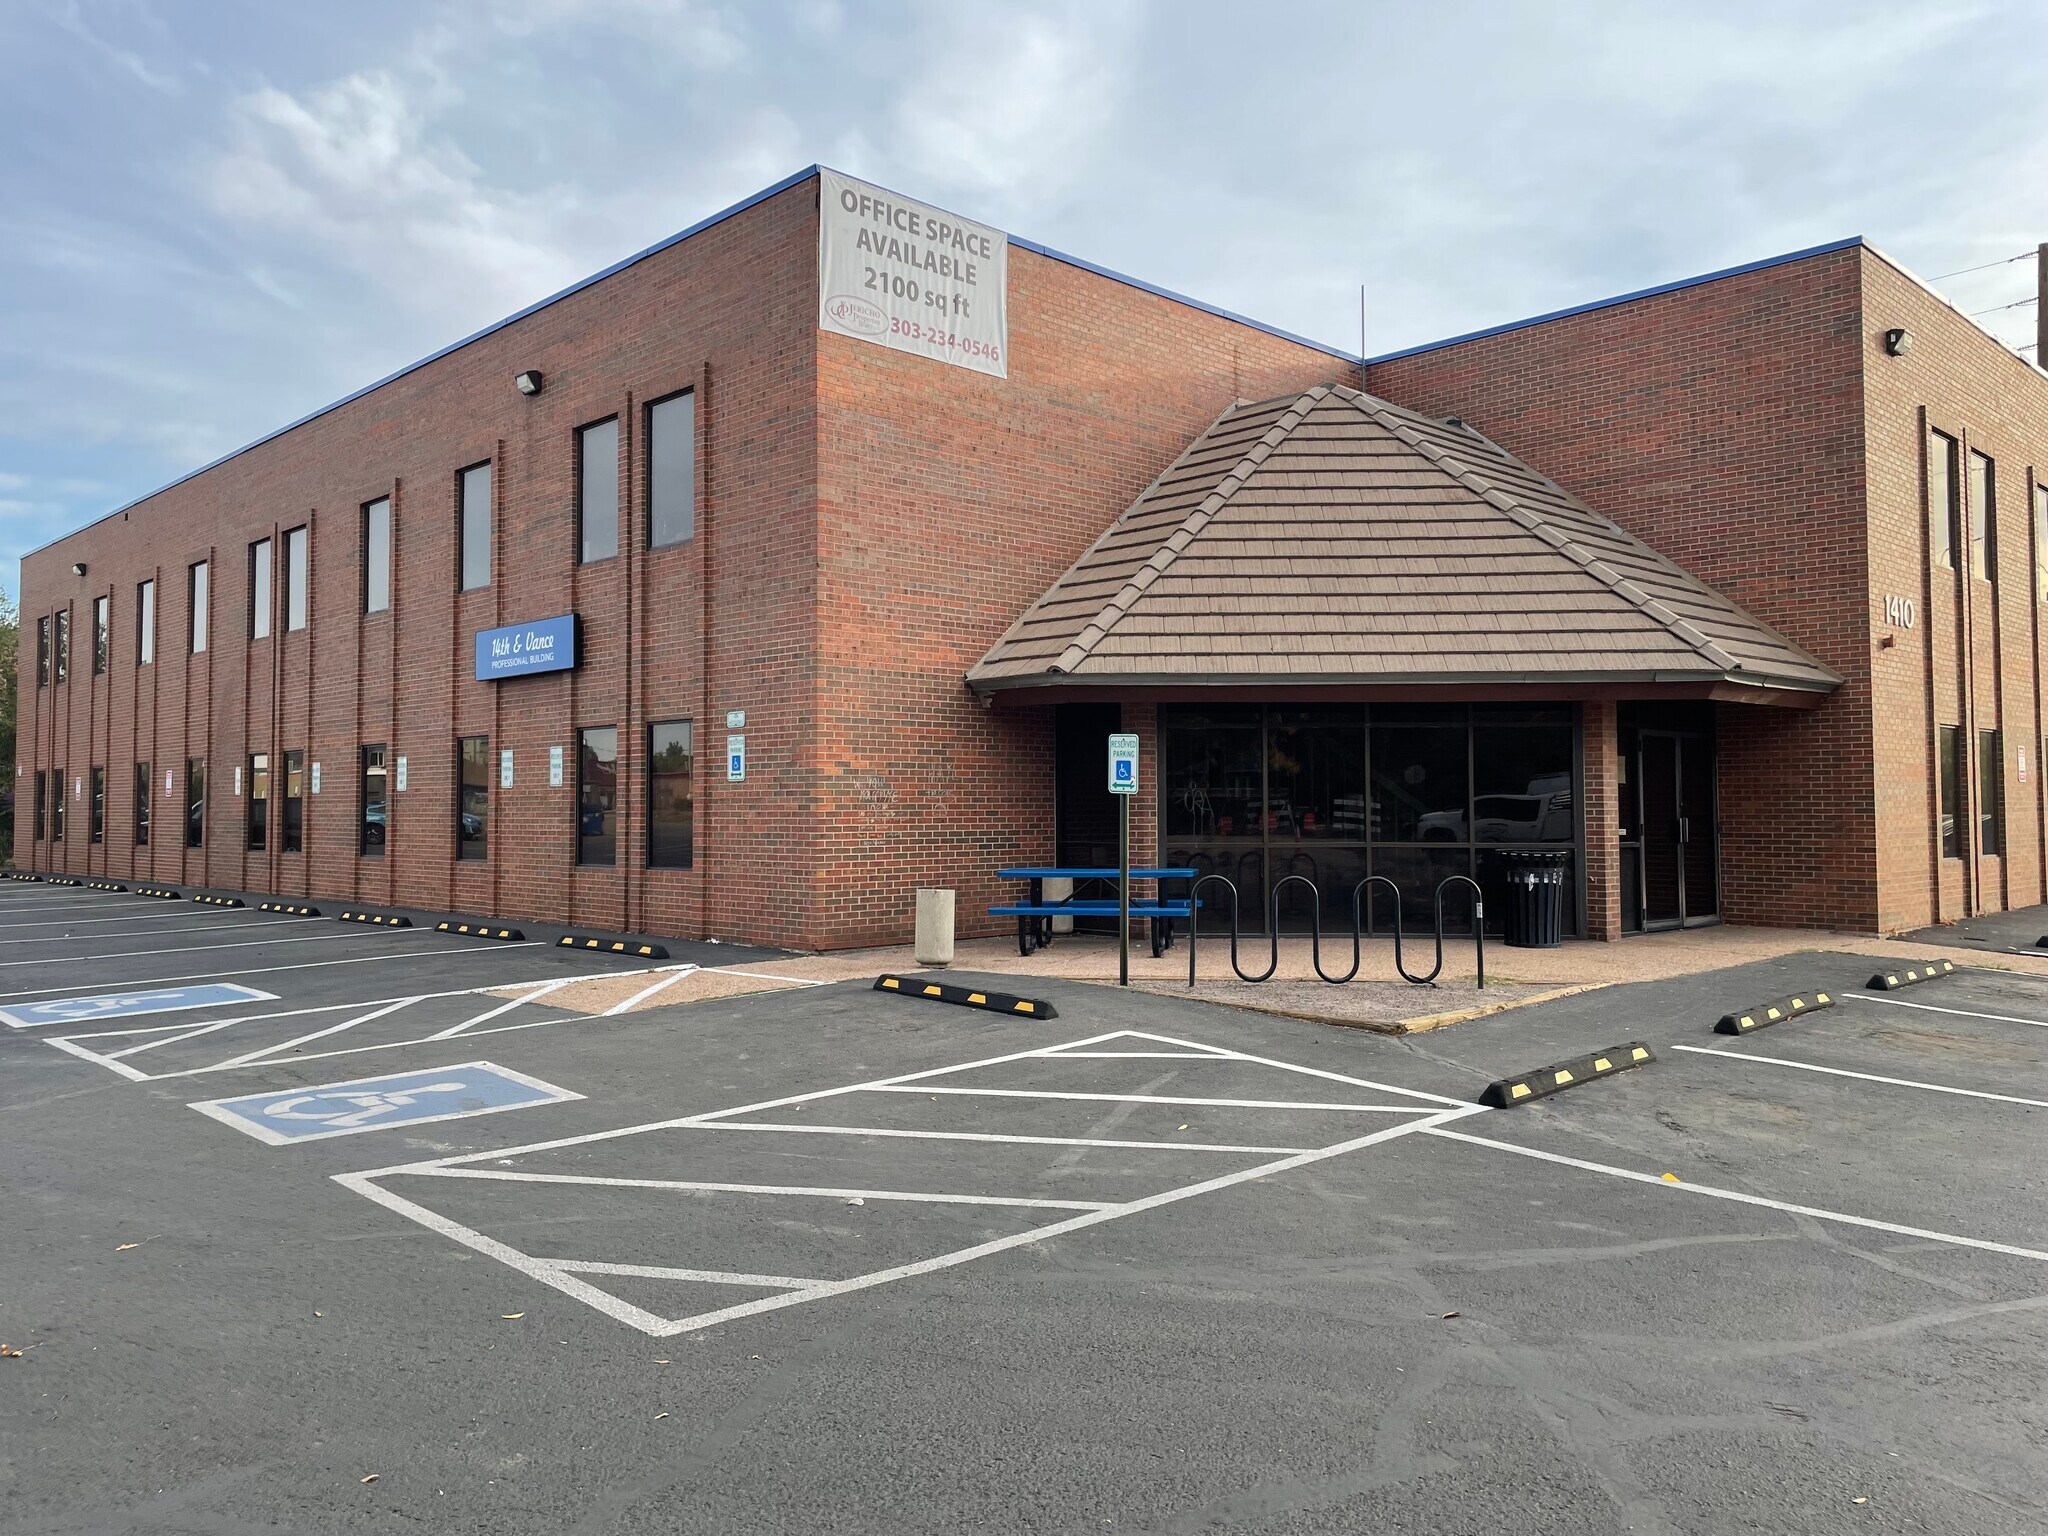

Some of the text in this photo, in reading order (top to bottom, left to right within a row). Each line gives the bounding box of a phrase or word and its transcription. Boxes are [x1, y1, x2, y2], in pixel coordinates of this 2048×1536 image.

[840, 189, 991, 260] OFFICE SPACE
[856, 228, 977, 286] AVAILABLE
[864, 267, 970, 318] 2100 sq ft
[848, 304, 881, 319] JERICHO
[891, 316, 1000, 361] 303-234-0546
[1884, 594, 1915, 629] 1410
[492, 632, 554, 656] 14th & Vance
[492, 652, 554, 669] PROFESSIONAL BUILDING
[1113, 750, 1135, 758] PARKING
